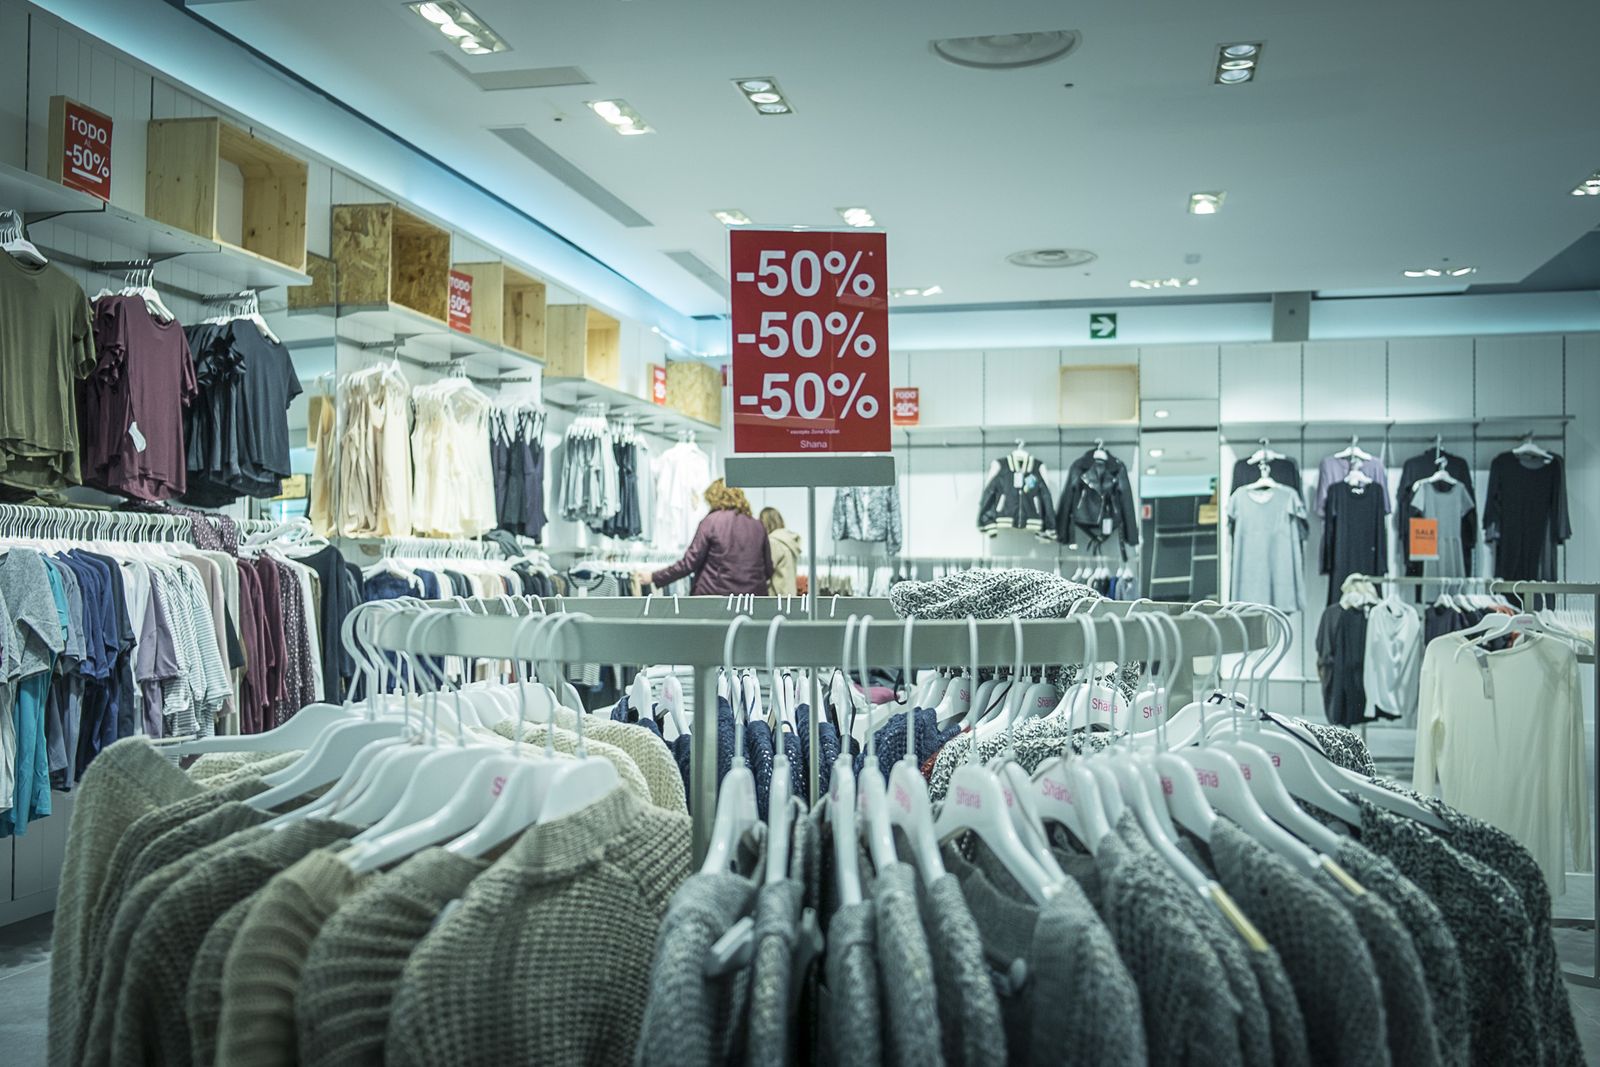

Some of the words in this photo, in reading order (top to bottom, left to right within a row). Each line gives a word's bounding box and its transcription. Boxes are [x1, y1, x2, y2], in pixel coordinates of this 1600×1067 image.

[69, 114, 107, 144] TODO
[66, 144, 109, 177] -50%
[737, 311, 877, 358] -50%
[740, 372, 879, 420] -50%
[800, 440, 828, 449] Shana
